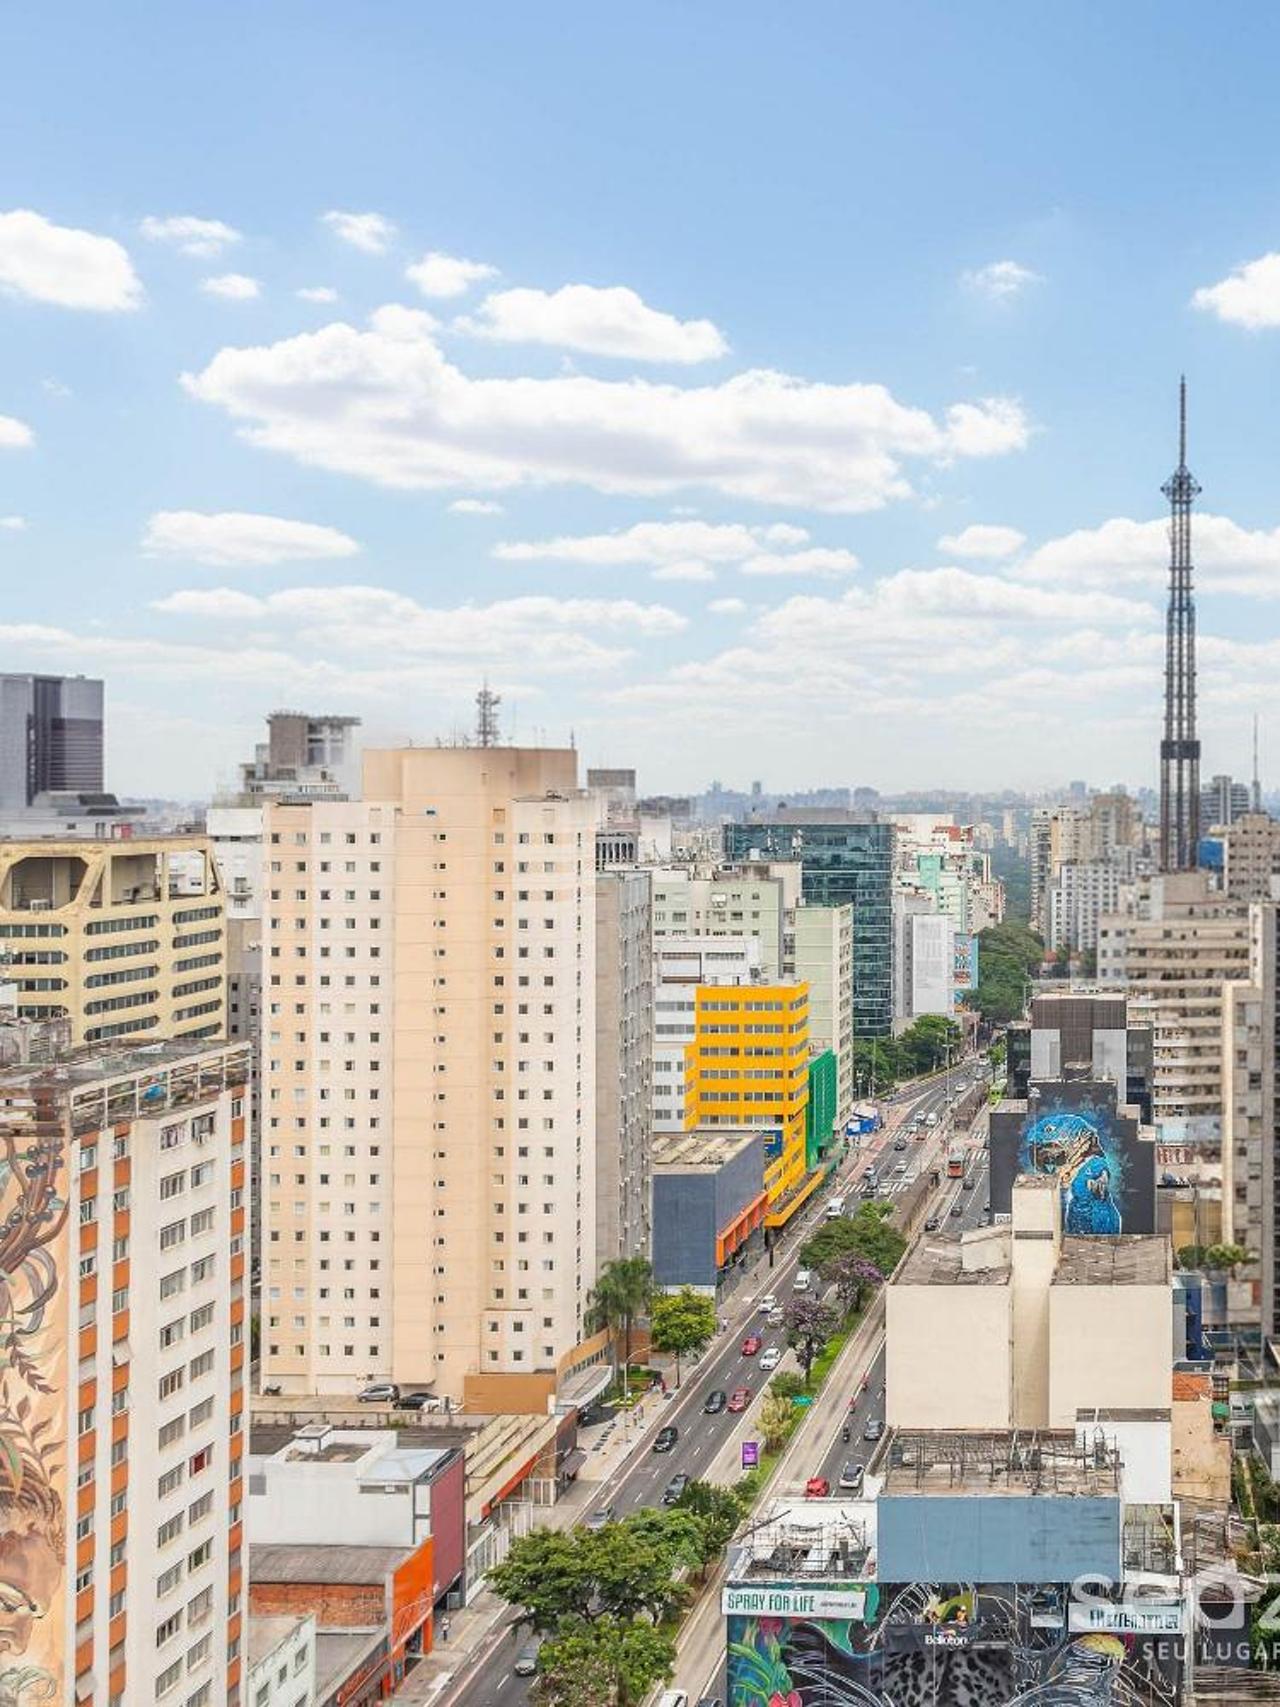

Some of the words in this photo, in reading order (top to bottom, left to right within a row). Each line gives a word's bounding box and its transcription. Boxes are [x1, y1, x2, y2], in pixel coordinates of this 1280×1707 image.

[727, 1592, 766, 1610] SPRAY
[768, 1594, 790, 1611] FOR
[792, 1595, 816, 1613] LIFE
